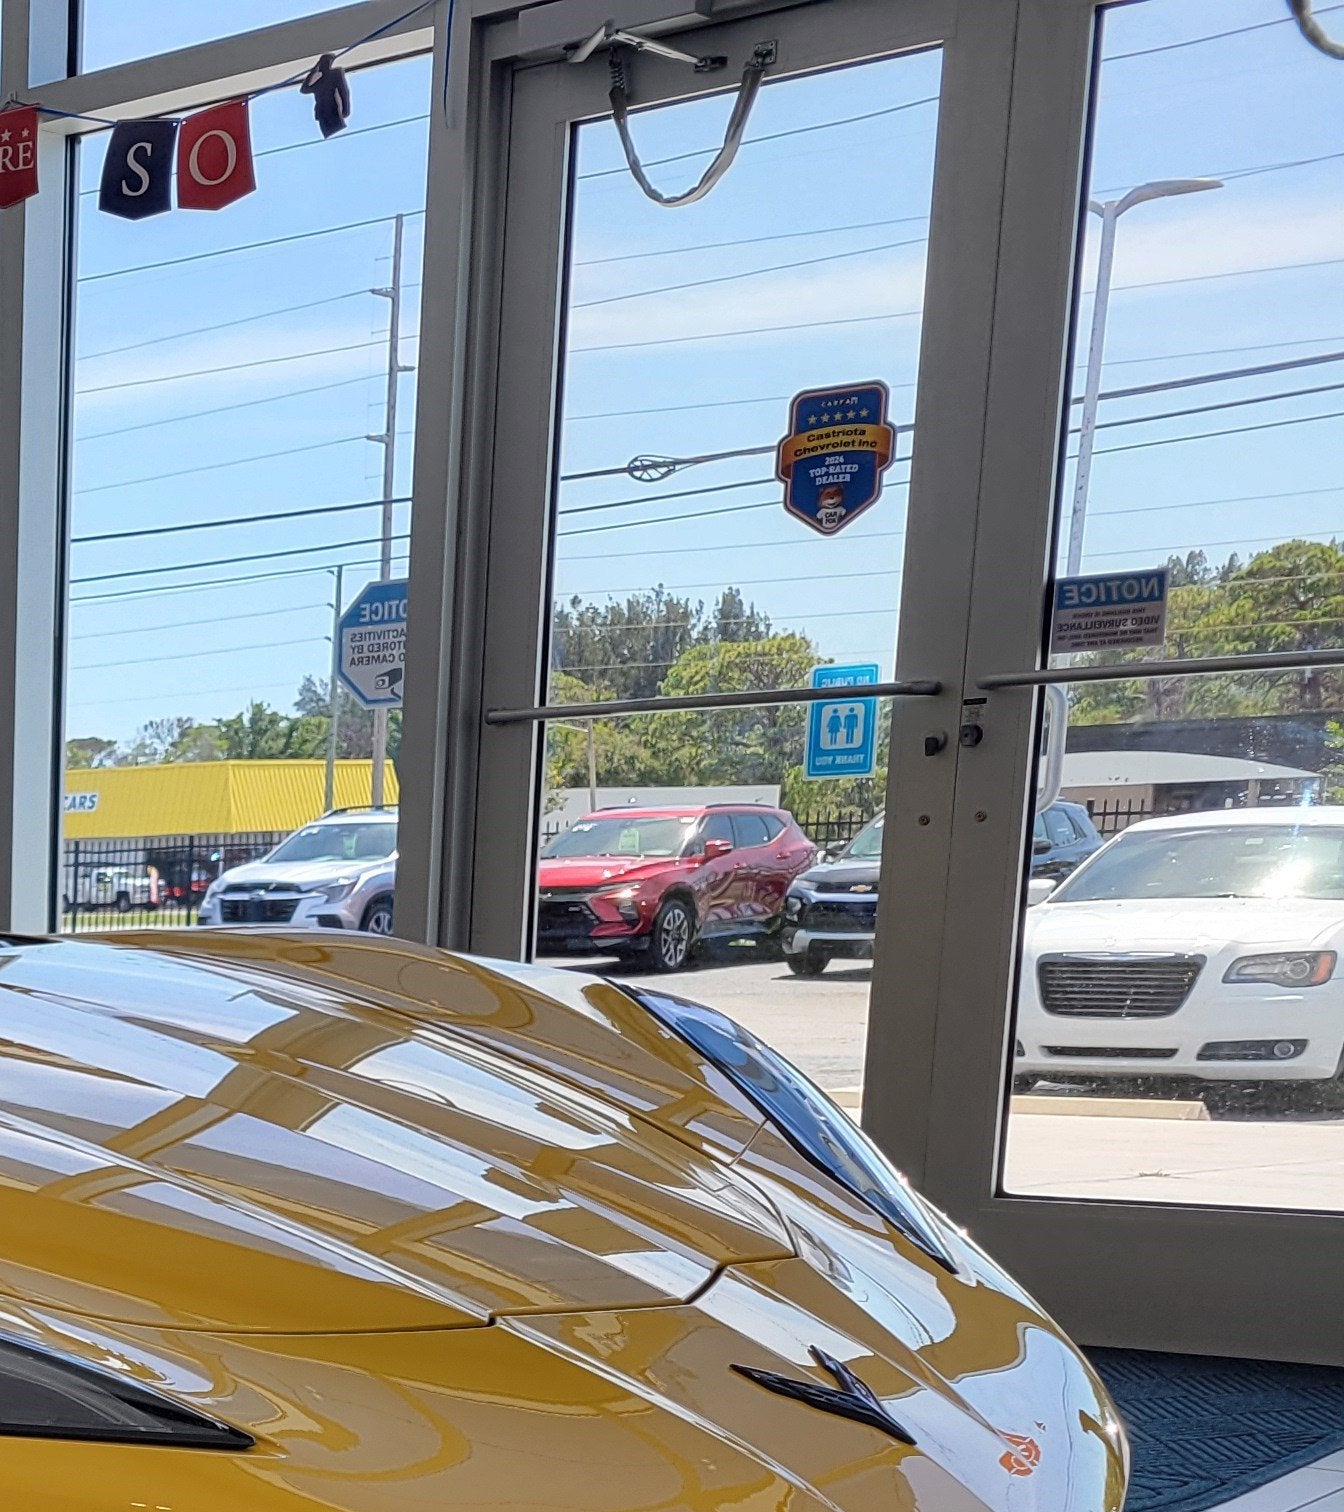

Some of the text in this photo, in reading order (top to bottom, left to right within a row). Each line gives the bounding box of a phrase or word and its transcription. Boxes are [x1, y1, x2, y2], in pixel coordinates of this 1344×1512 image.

[121, 130, 237, 196] SO
[806, 427, 867, 443] Castriota
[793, 439, 878, 458] Chevrolet Inc
[824, 455, 845, 465] 2024
[809, 464, 859, 478] TOP-RATED
[815, 474, 851, 486] DEALER
[824, 511, 838, 519] CAR
